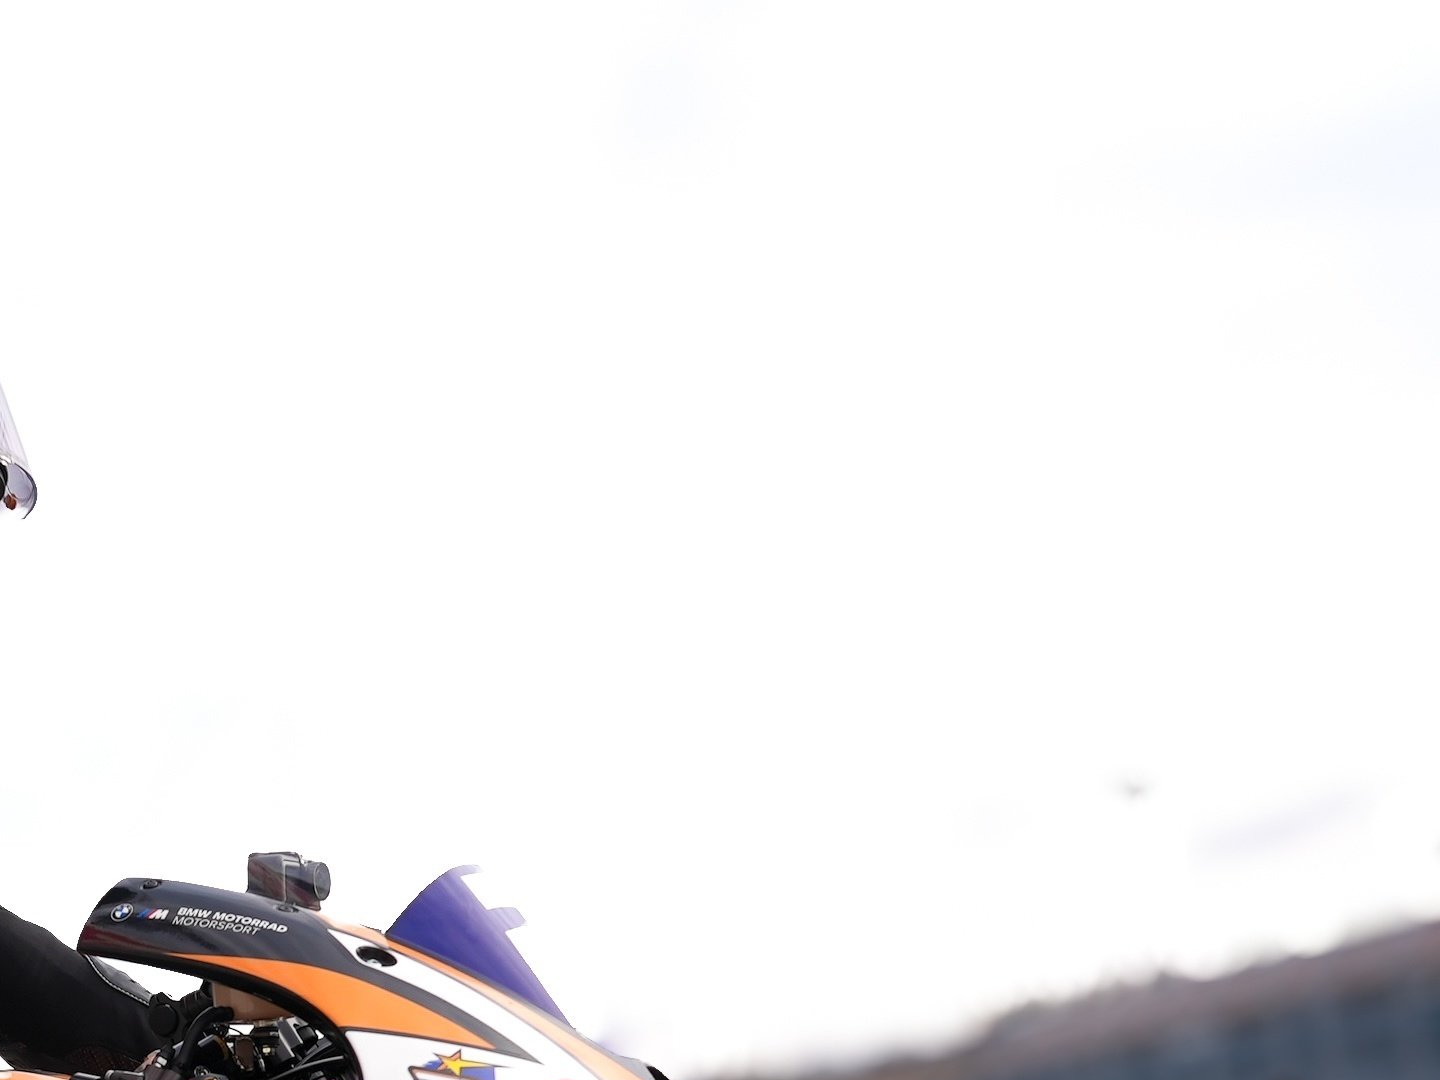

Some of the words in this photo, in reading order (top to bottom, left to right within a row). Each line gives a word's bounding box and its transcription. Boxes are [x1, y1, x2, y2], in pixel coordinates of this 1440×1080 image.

[172, 916, 262, 936] MOTORSPORT
[177, 907, 211, 919] BMW
[214, 912, 288, 933] MOTORRAD
